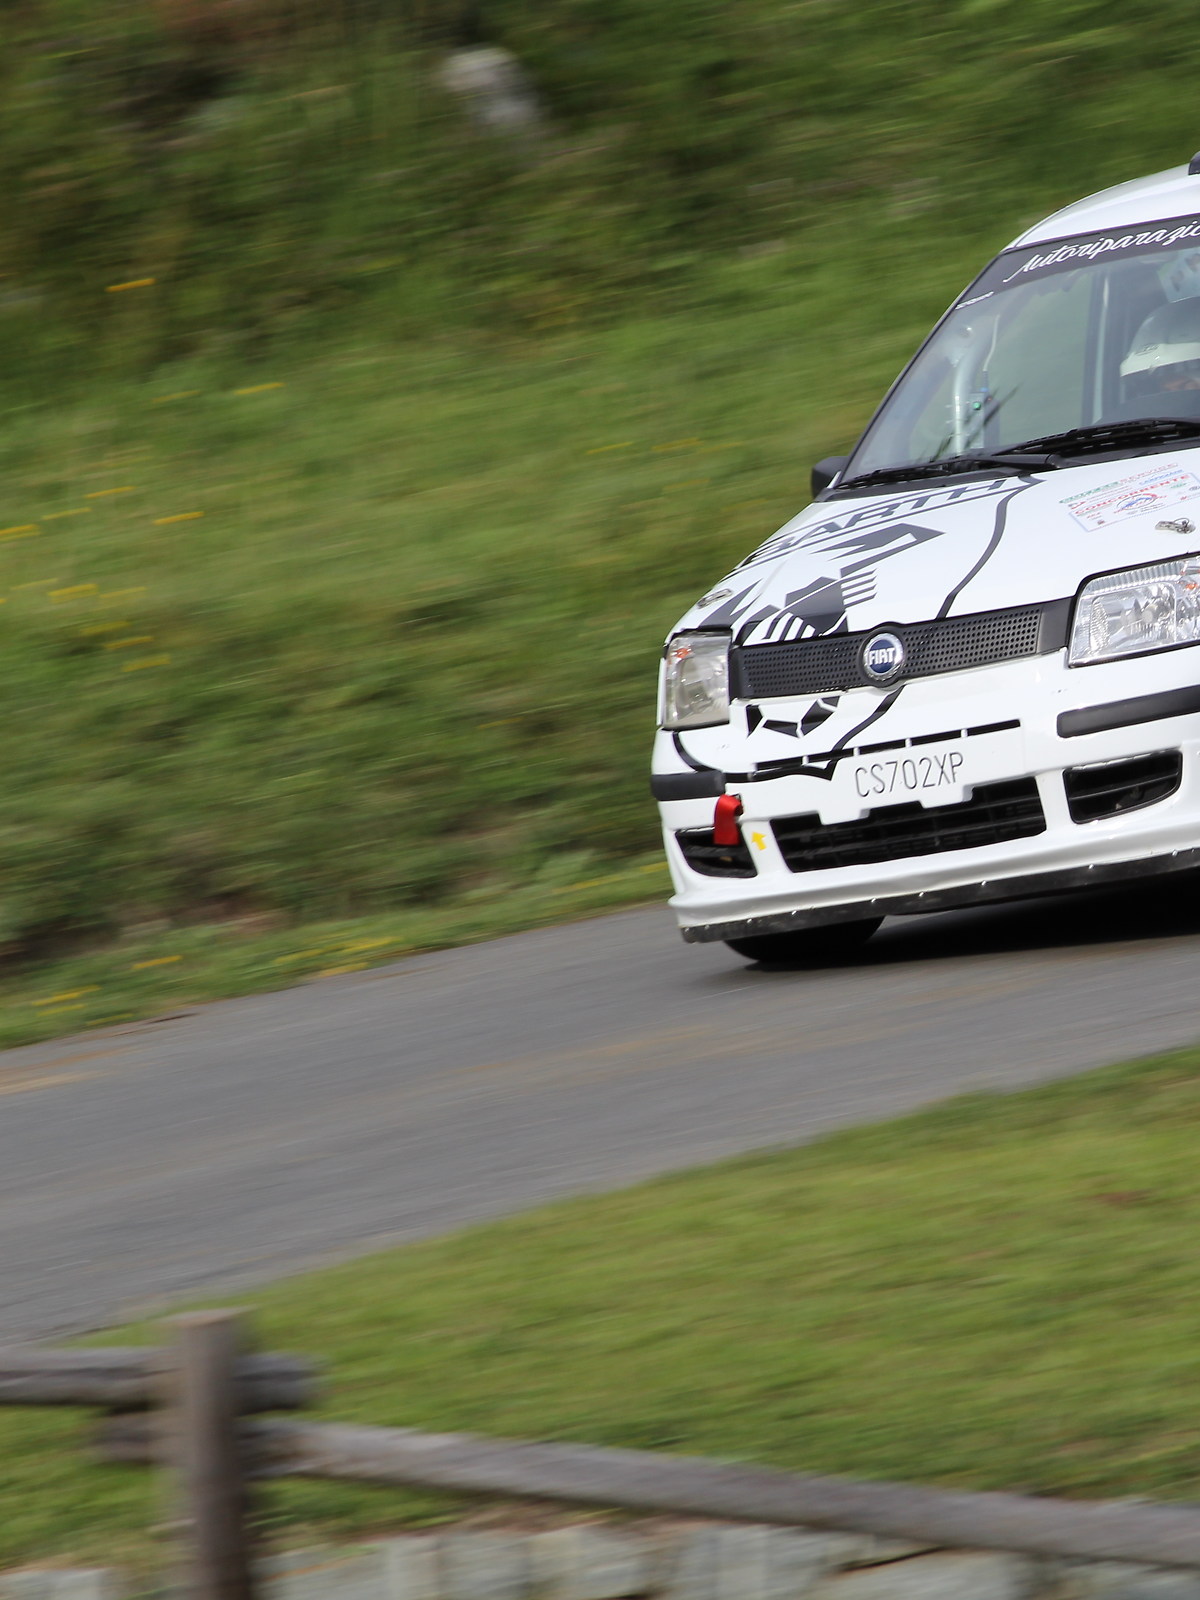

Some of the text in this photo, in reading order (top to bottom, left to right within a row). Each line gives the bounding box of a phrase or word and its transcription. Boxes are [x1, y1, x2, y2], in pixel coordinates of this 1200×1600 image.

[1075, 474, 1191, 515] CONCORRENTE
[868, 648, 896, 667] FIAT
[855, 751, 965, 798] CS702XP
